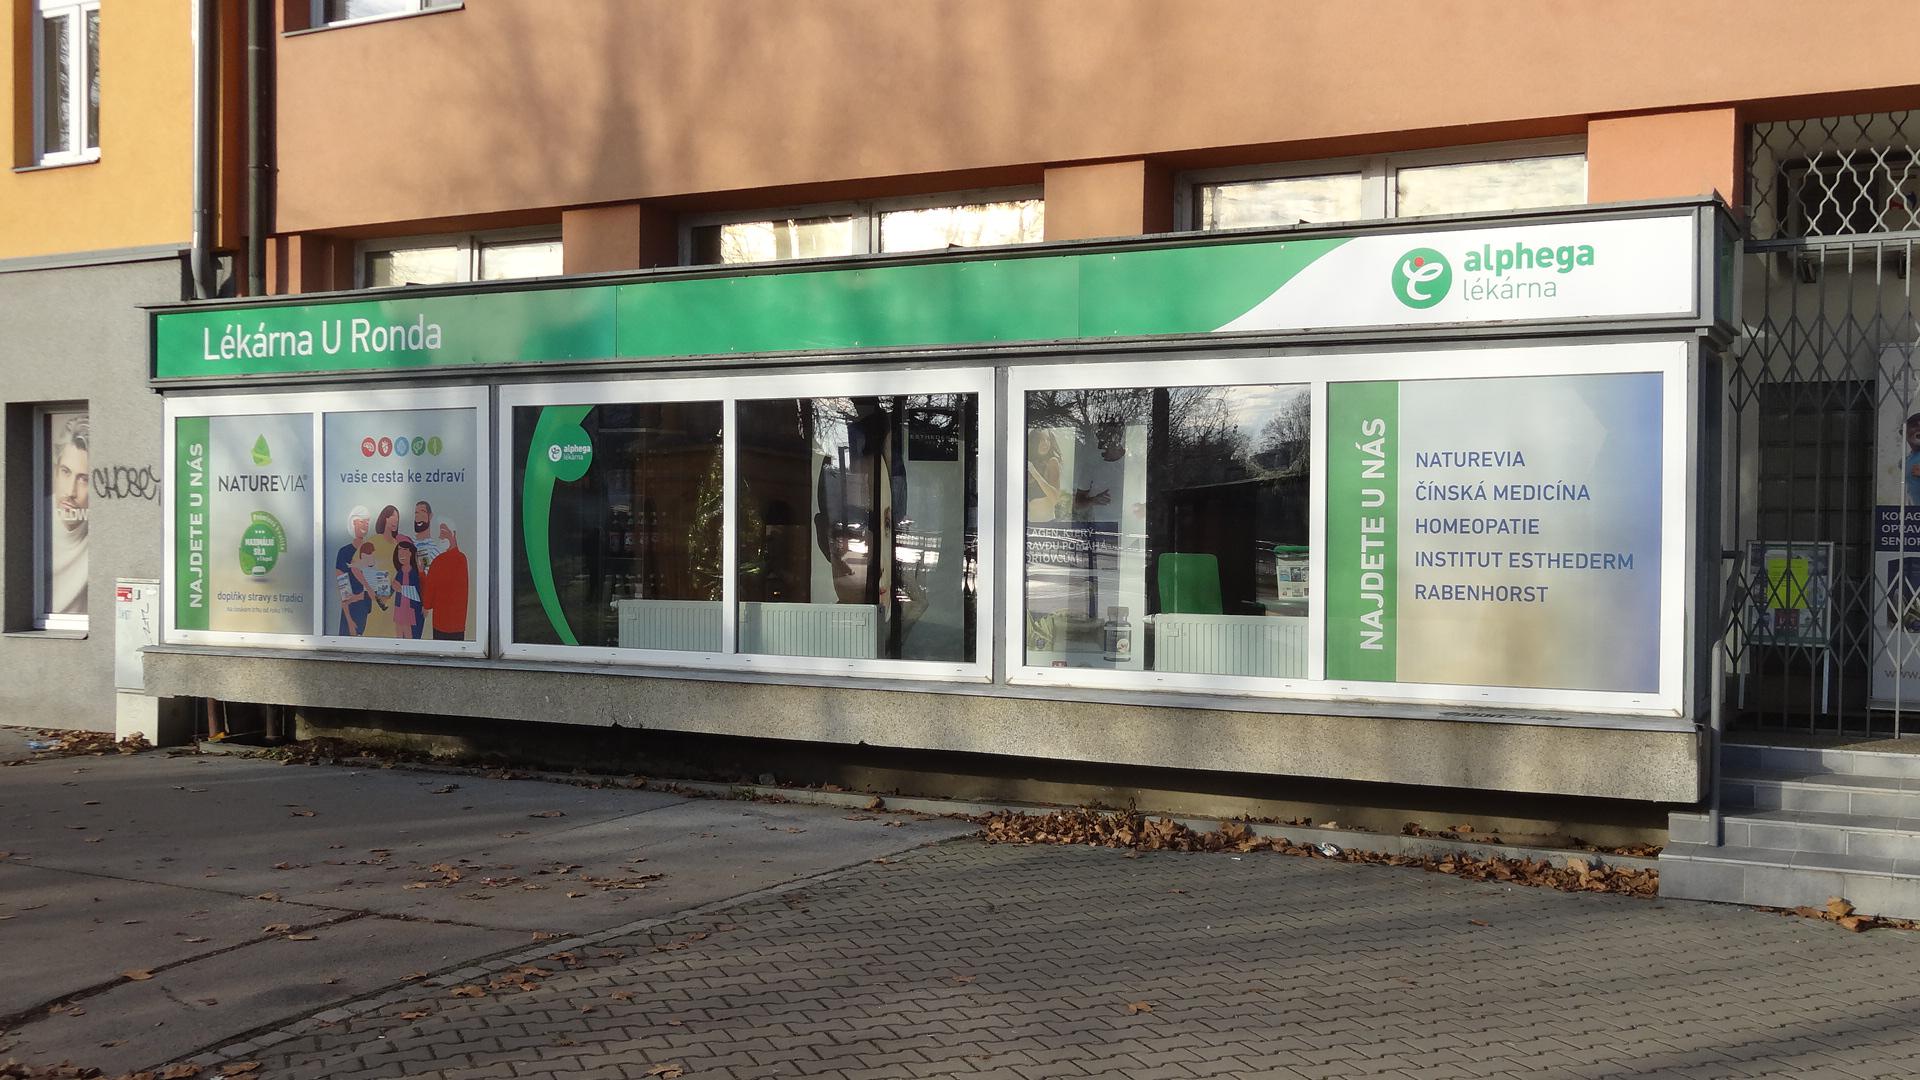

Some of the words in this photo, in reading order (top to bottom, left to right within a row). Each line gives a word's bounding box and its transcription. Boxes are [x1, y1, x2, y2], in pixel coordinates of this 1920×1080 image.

[1464, 242, 1595, 276] alphega
[1464, 276, 1558, 301] lékárna
[204, 322, 313, 360] Lékárna
[322, 319, 342, 354] U
[352, 314, 442, 353] Ronda
[563, 444, 591, 454] alphega
[1355, 418, 1386, 478] NÁS
[186, 443, 203, 487] NÁS
[1416, 451, 1526, 468] NATUREVIA
[340, 469, 368, 483] vaše
[371, 470, 404, 482] cesta
[408, 469, 422, 482] ke
[426, 468, 465, 482] zdraví
[189, 494, 203, 507] U
[1362, 489, 1385, 508] U
[1415, 480, 1487, 501] ČÍNSKÁ
[1493, 480, 1591, 501] MEDICÍNA
[1415, 518, 1540, 535] HOMEOPATIE
[189, 513, 203, 608] NAJDETE
[1415, 551, 1503, 568] INSTITUT
[1509, 552, 1634, 570] ESTHEDERM
[1360, 517, 1385, 650] NAJDETE
[1415, 584, 1549, 603] RABENHORST
